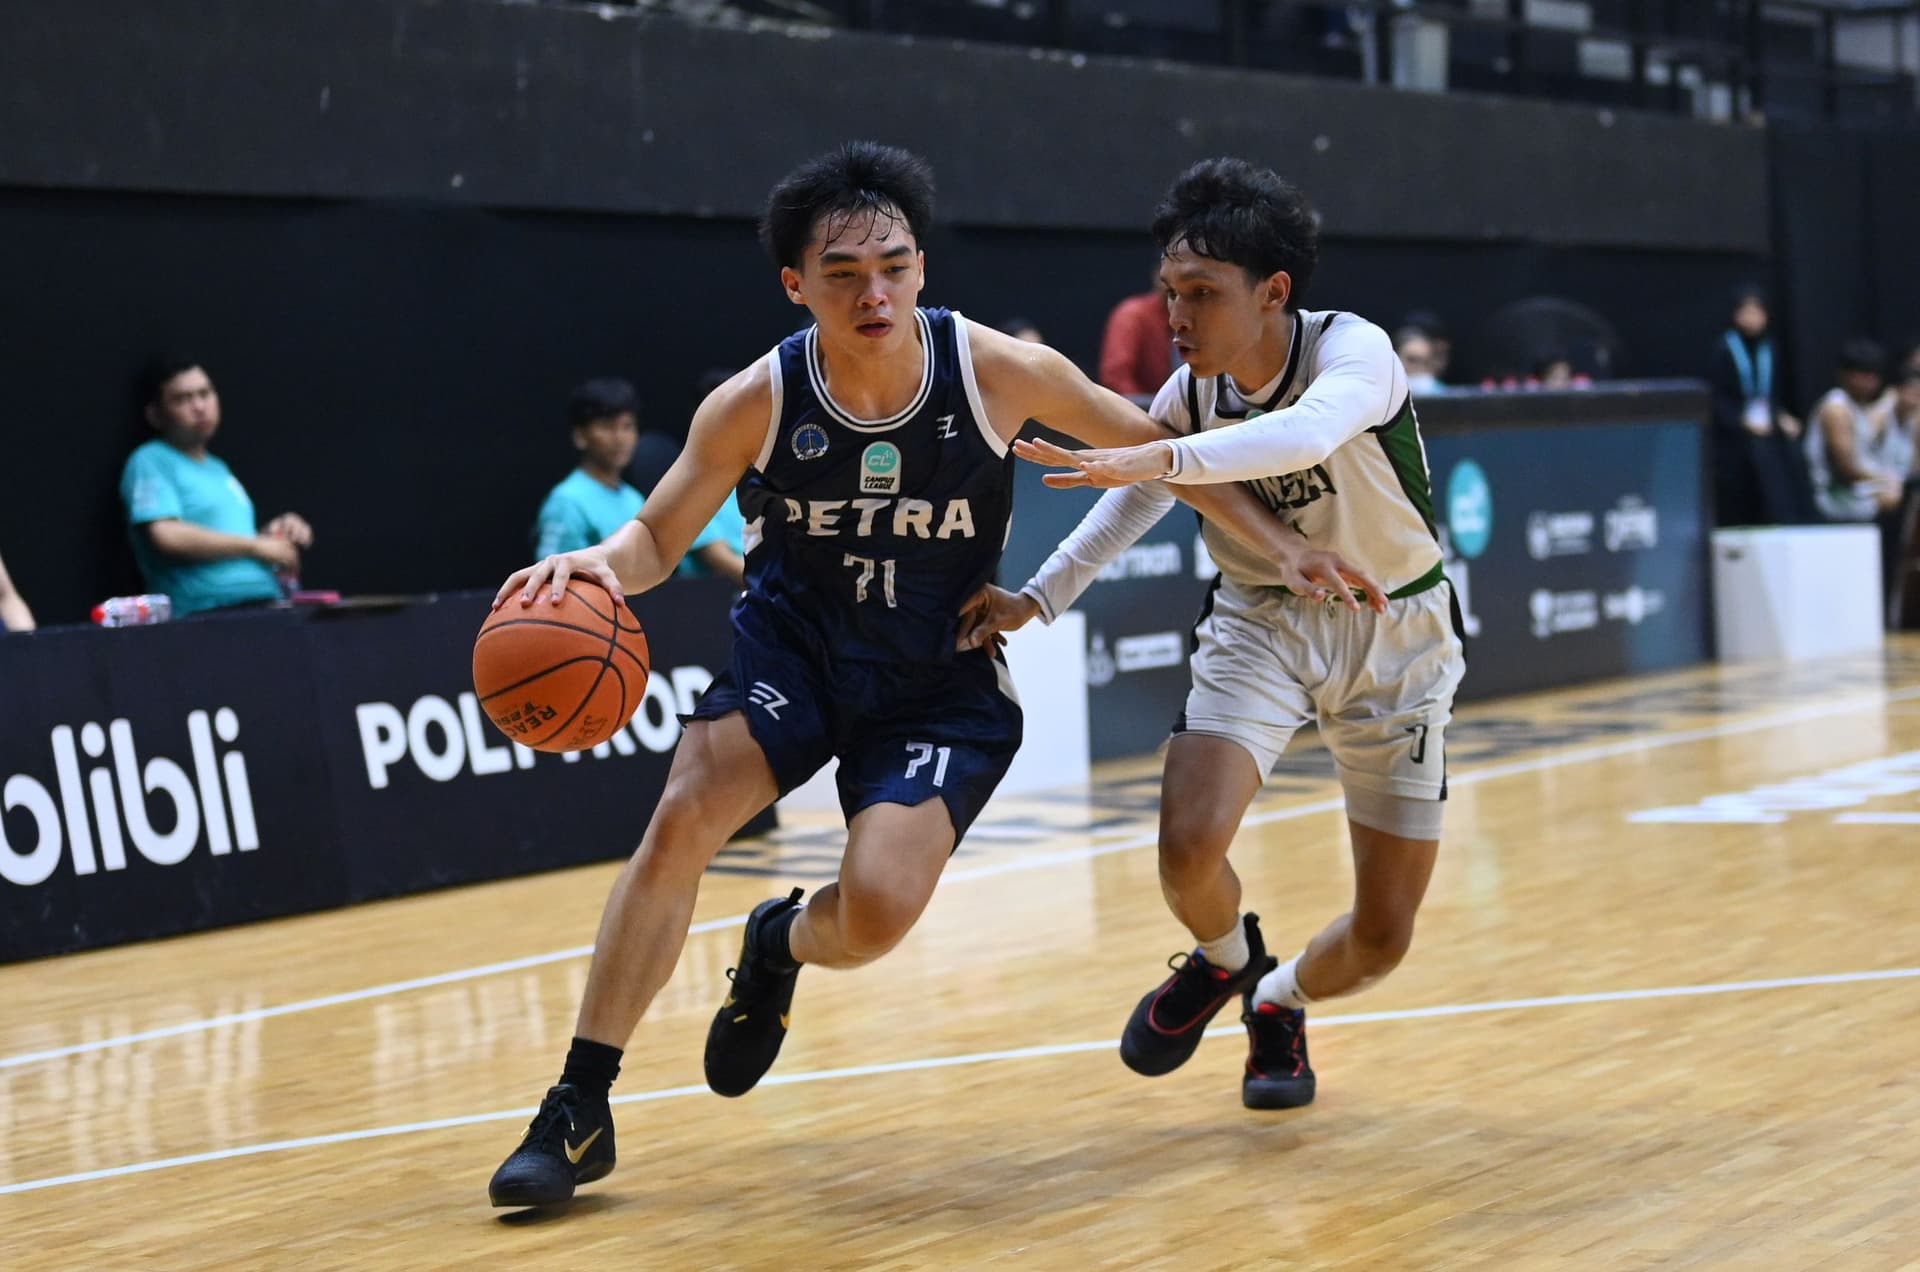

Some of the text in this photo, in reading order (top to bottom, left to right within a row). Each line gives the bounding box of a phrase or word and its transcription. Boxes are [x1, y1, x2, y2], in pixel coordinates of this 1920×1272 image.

[864, 476, 896, 484] CAMPUS
[864, 482, 893, 490] LEAGUE
[843, 552, 898, 609] 71
[904, 740, 951, 787] 71
